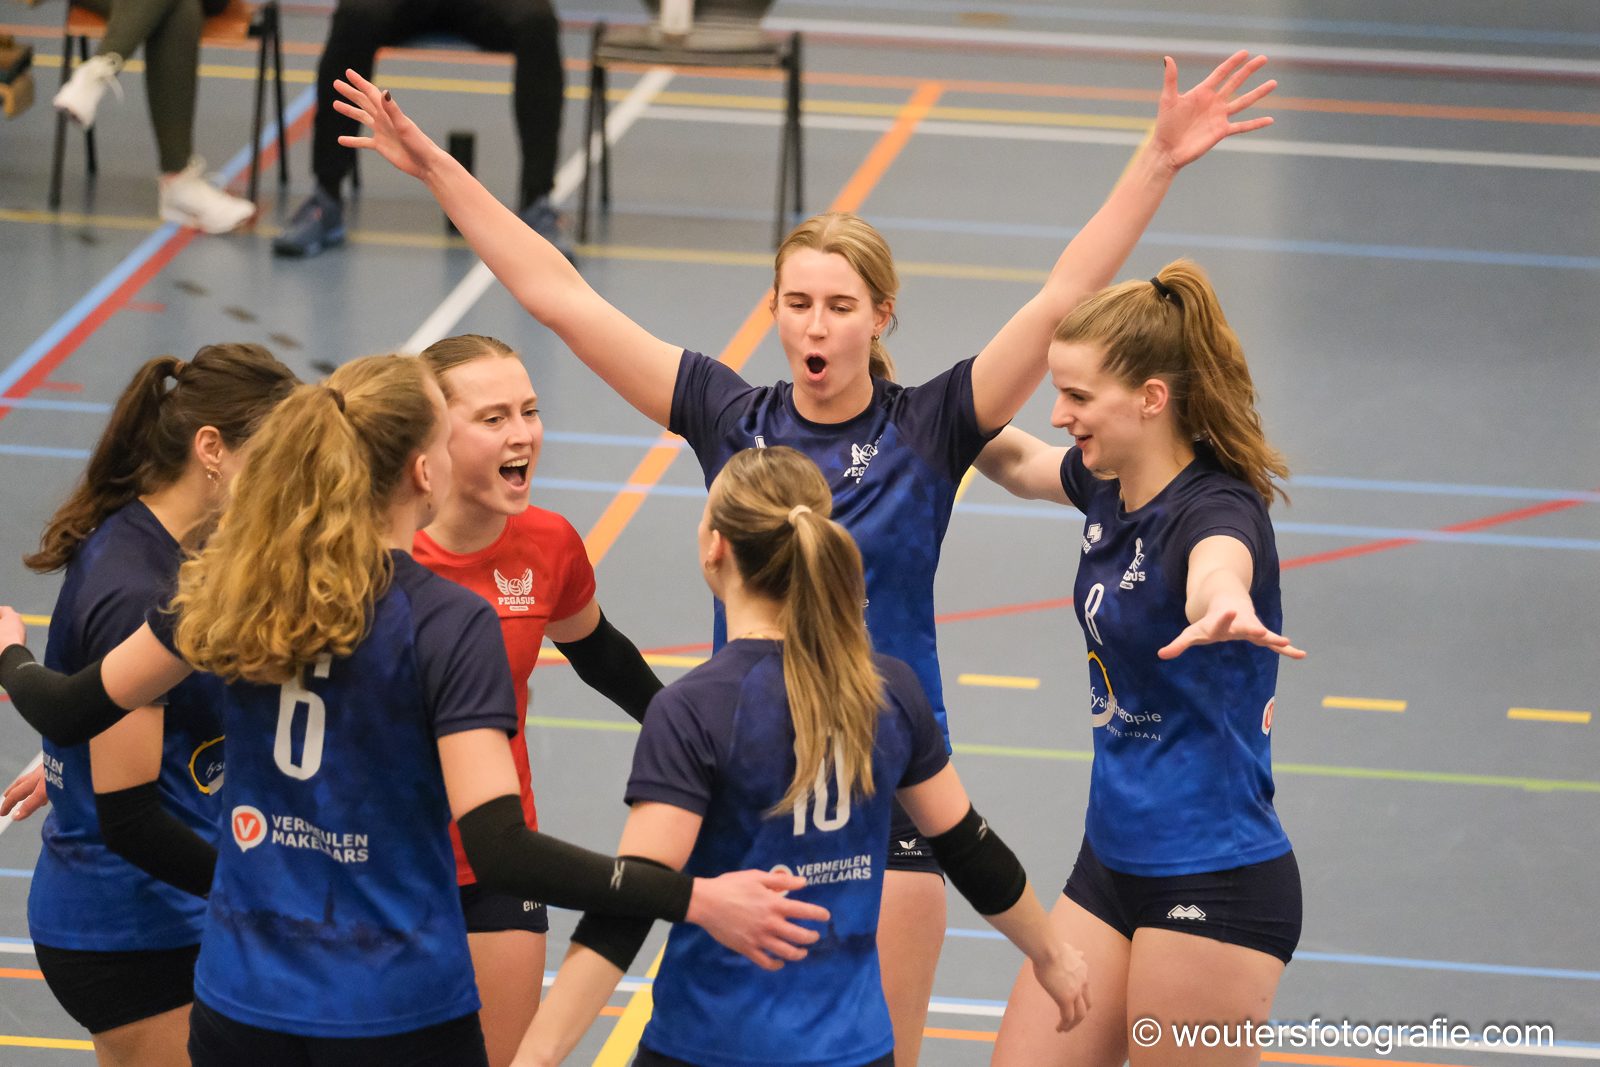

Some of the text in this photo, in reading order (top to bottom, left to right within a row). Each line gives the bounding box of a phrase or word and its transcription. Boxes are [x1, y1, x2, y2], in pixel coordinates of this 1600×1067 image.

[497, 596, 536, 605] PEGASUS
[273, 653, 333, 781] 6
[1091, 687, 1162, 725] fysioherapie
[271, 814, 368, 848] VERMEULEN
[271, 829, 369, 864] MAKELAARS
[796, 854, 872, 876] VERMEULEN
[804, 867, 872, 886] AKELAARS
